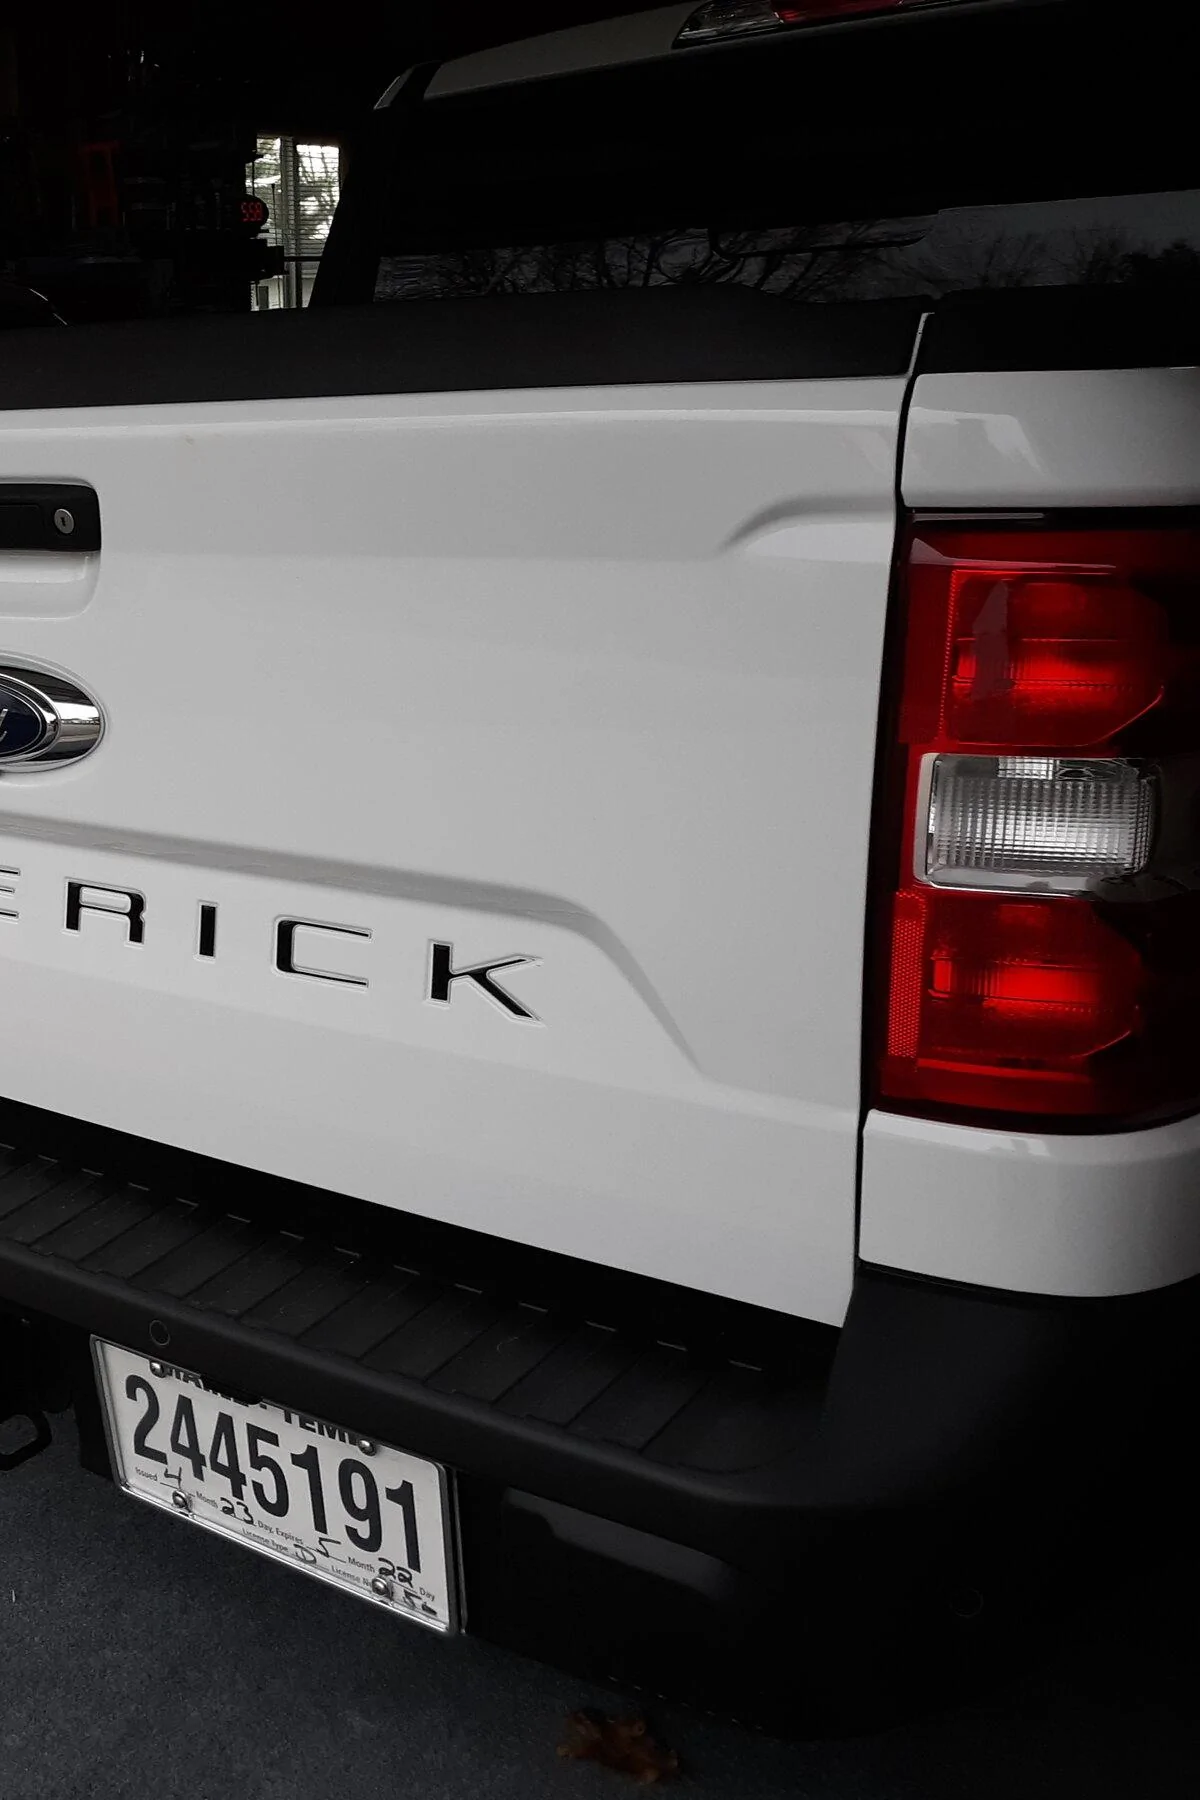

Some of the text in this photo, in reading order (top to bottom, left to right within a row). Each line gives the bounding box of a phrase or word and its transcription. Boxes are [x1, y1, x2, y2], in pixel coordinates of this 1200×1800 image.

[126, 1375, 422, 1573] 2445191
[135, 1466, 158, 1482] Issued
[196, 1491, 219, 1509] Month
[276, 1527, 303, 1545] Expires
[347, 1556, 375, 1573] Month
[419, 1587, 436, 1602] Day
[242, 1527, 270, 1544] License
[271, 1539, 288, 1552] Type
[331, 1565, 361, 1583] License
